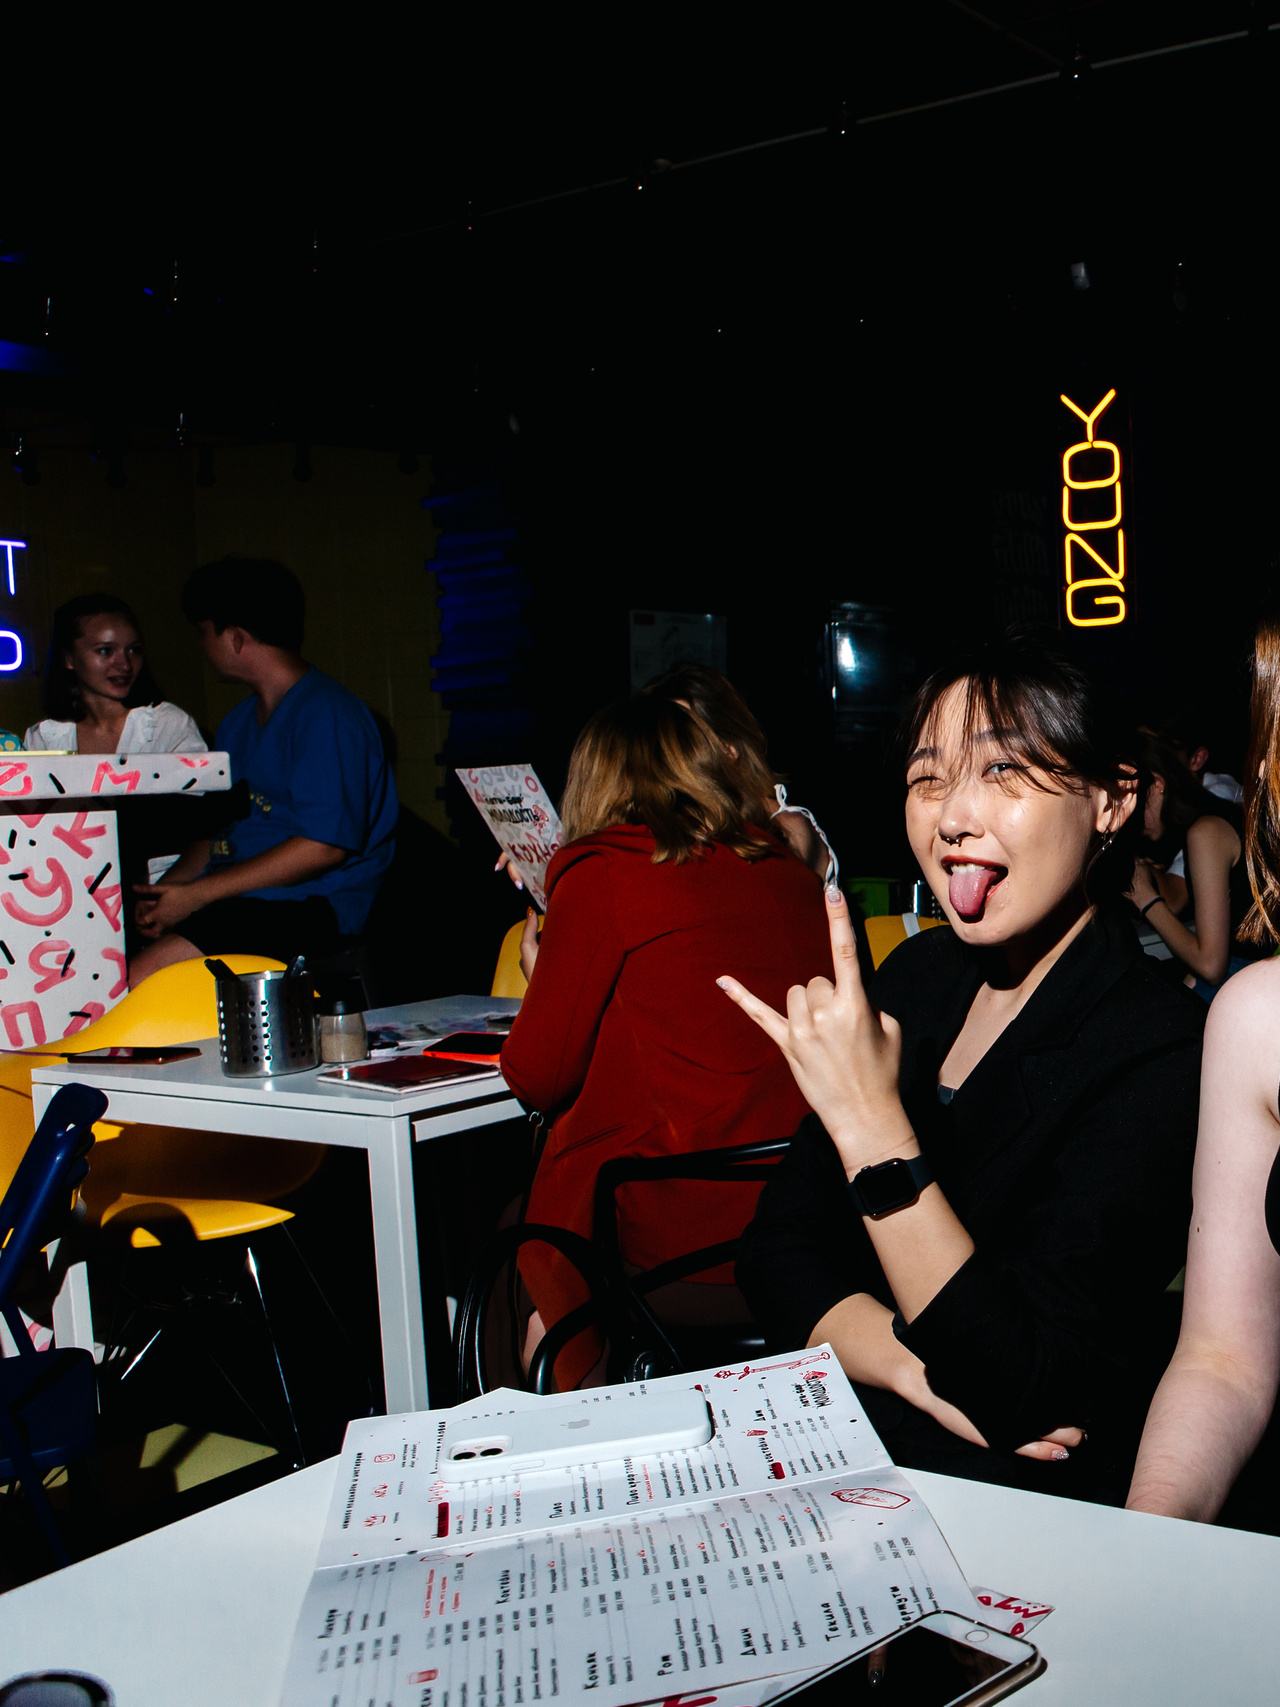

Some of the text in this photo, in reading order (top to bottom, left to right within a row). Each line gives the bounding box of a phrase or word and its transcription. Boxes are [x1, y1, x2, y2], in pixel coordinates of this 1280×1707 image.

[1060, 388, 1125, 627] YOUNG
[821, 1603, 840, 1642] Текила
[584, 1652, 598, 1689] Коньяк
